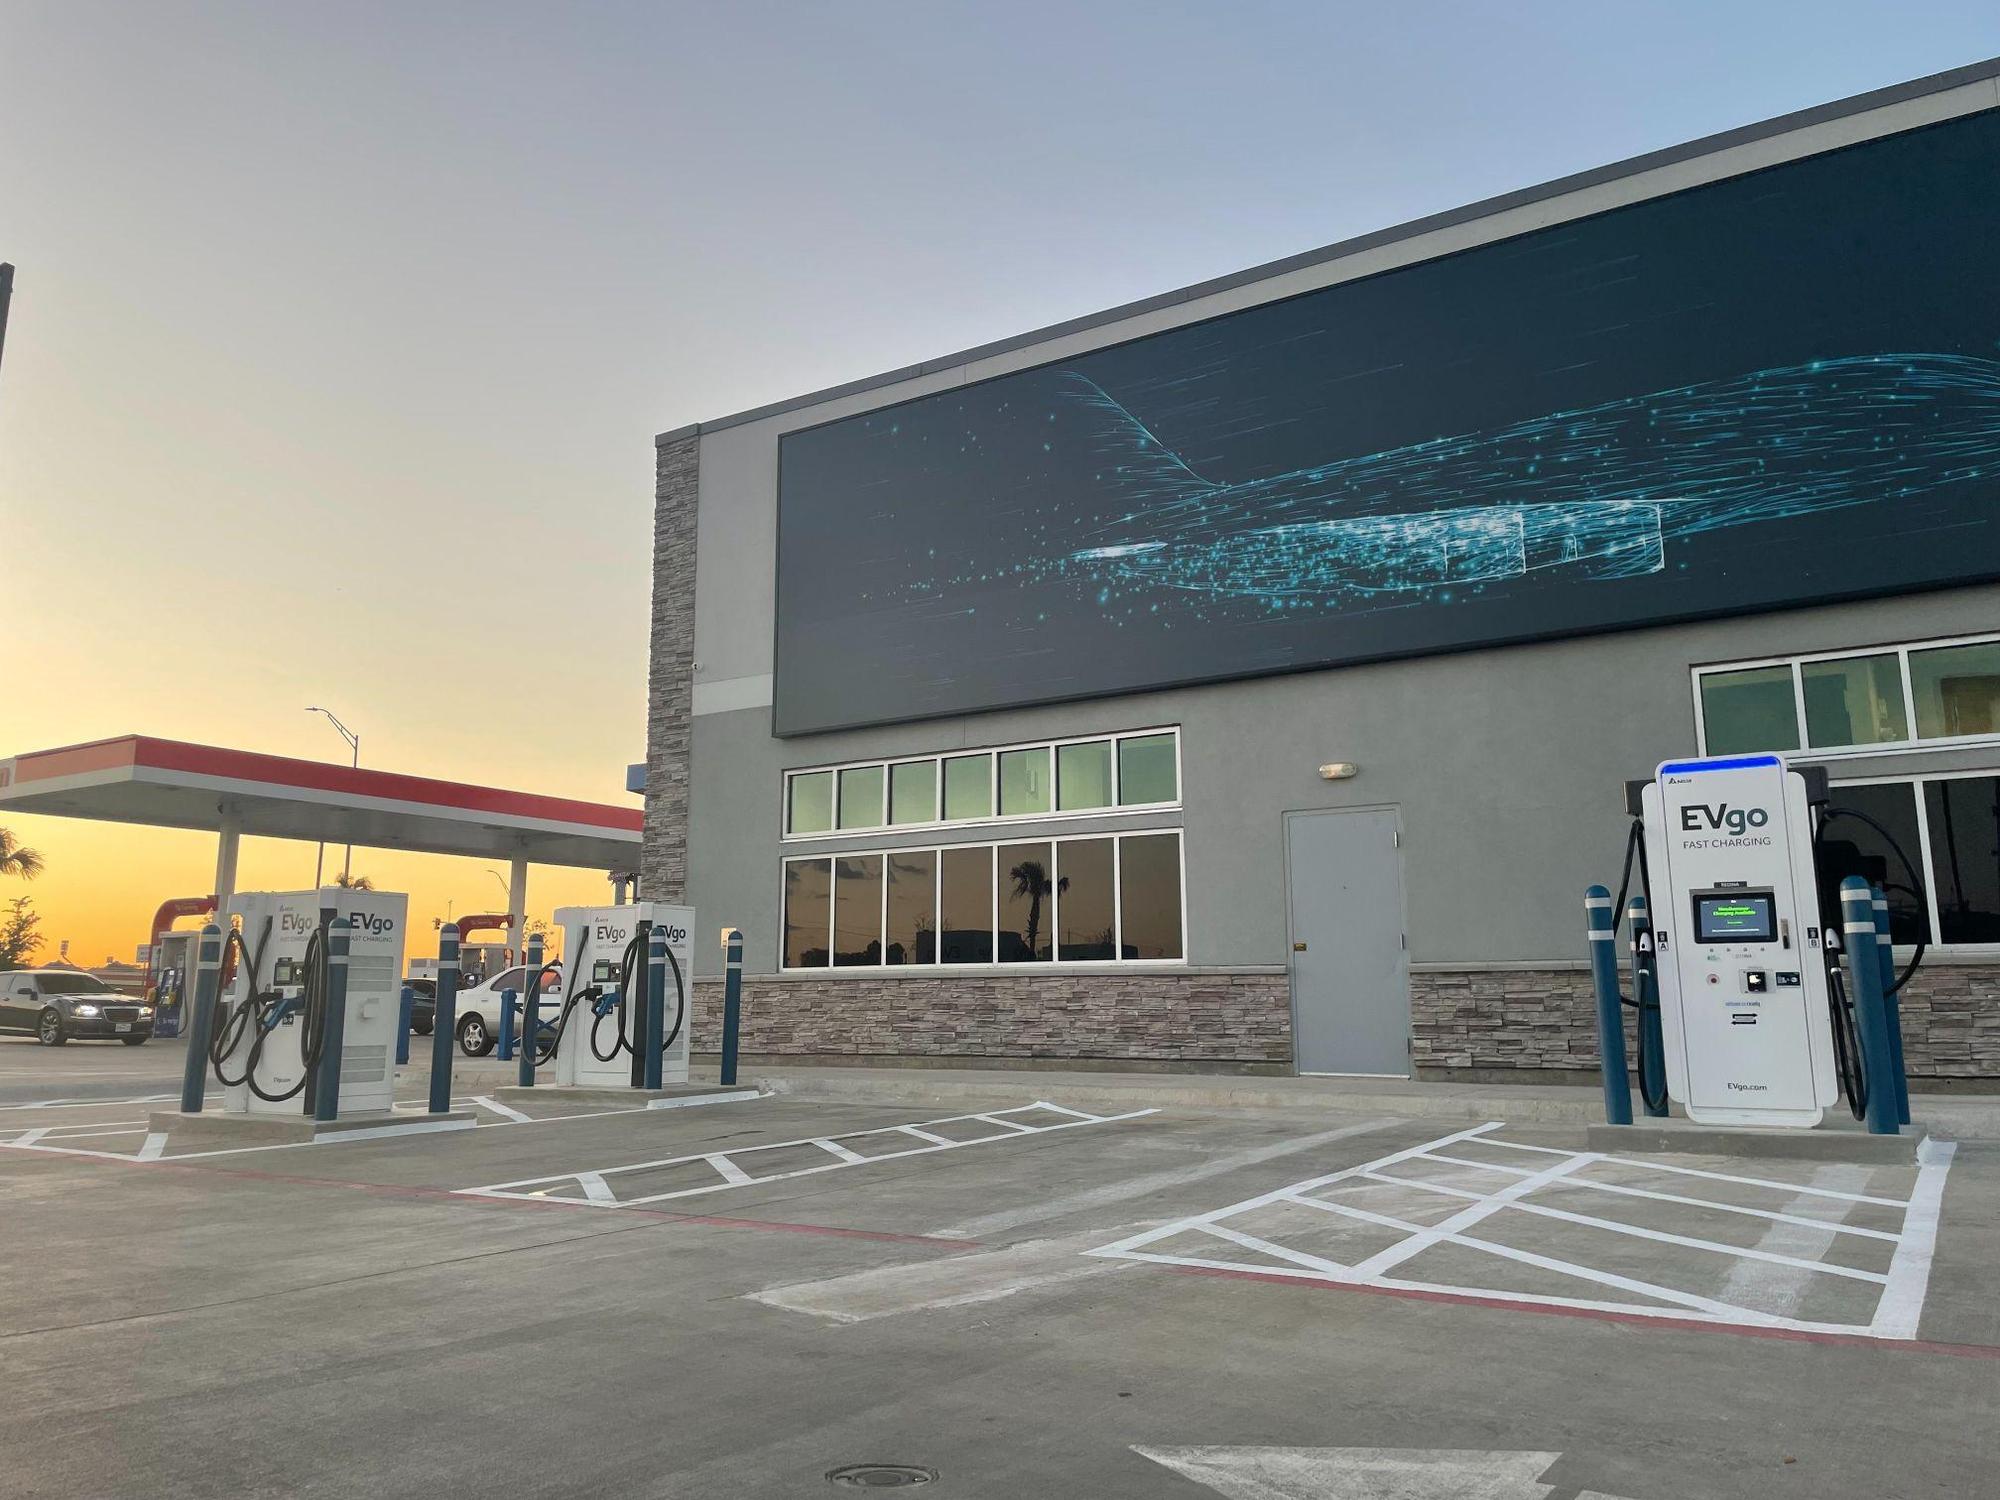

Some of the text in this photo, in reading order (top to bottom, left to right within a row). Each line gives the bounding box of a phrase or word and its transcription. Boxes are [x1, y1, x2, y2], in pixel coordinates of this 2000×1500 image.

[1680, 803, 1769, 836] EVgo
[1683, 836, 1772, 849] FAST CHARGING
[281, 913, 312, 935] EVgo
[349, 911, 394, 935] EVgo
[597, 925, 626, 943] EVgo
[1727, 1082, 1768, 1091] EVgo.com
